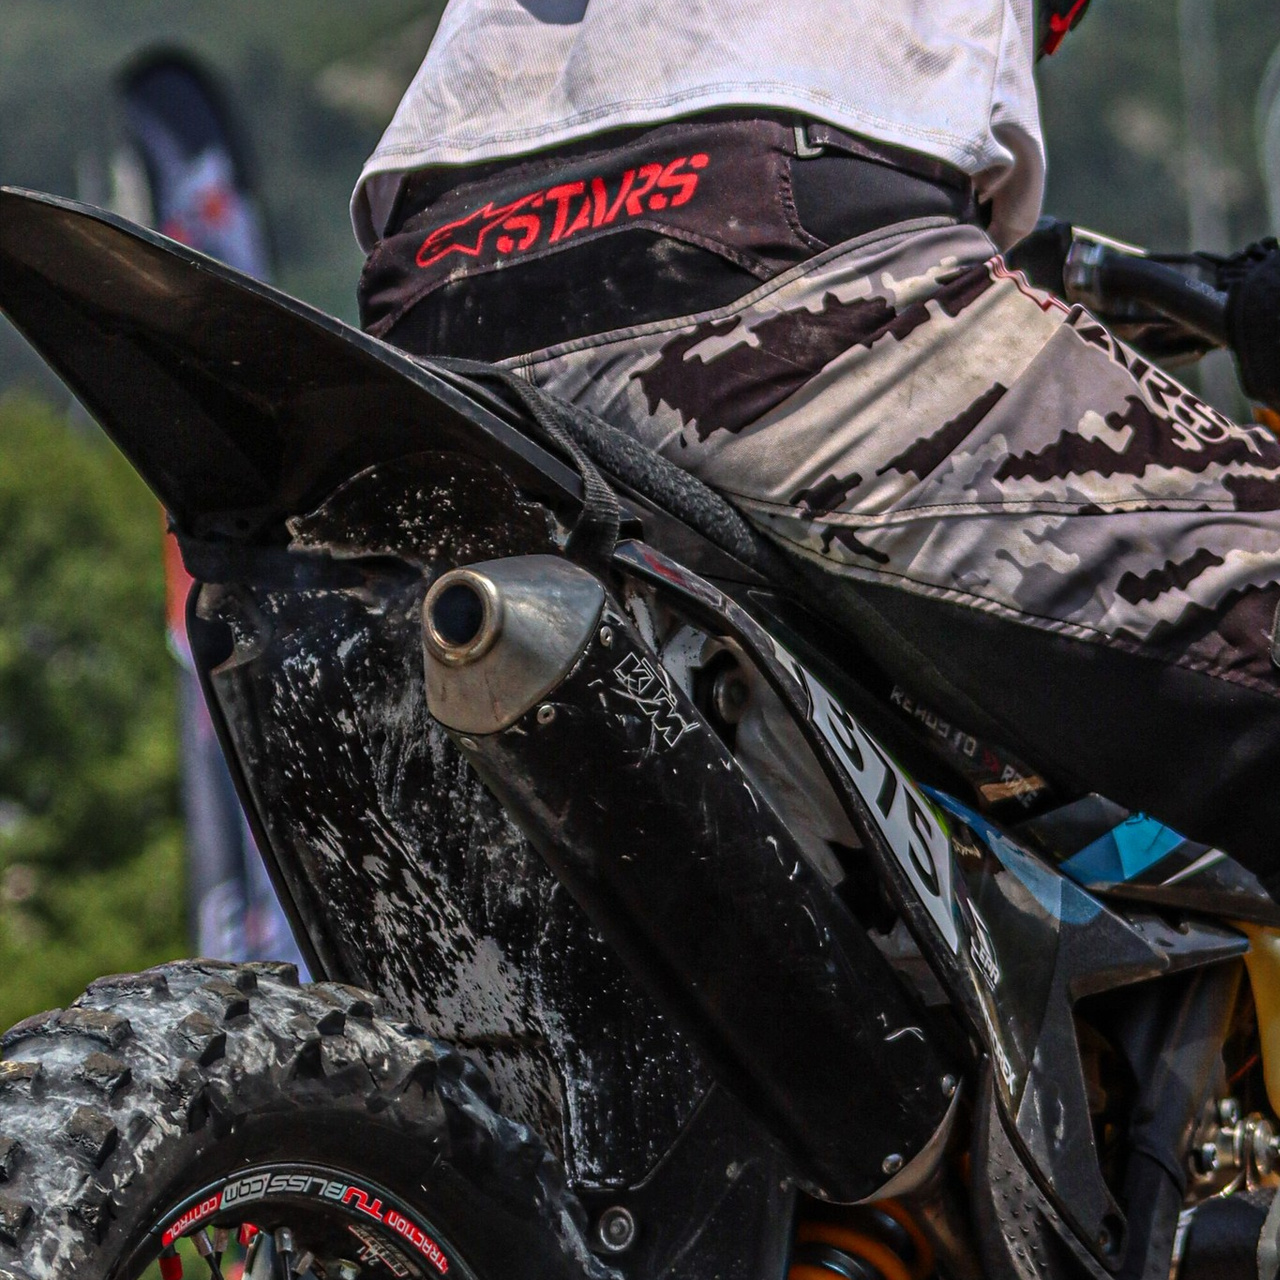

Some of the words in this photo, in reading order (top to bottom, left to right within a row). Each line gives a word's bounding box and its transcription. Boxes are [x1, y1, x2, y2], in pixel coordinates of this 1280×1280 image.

[613, 652, 687, 748] KTM
[826, 693, 941, 898] 375
[165, 1196, 218, 1239] CONTROL
[388, 1212, 446, 1271] TRACTION
